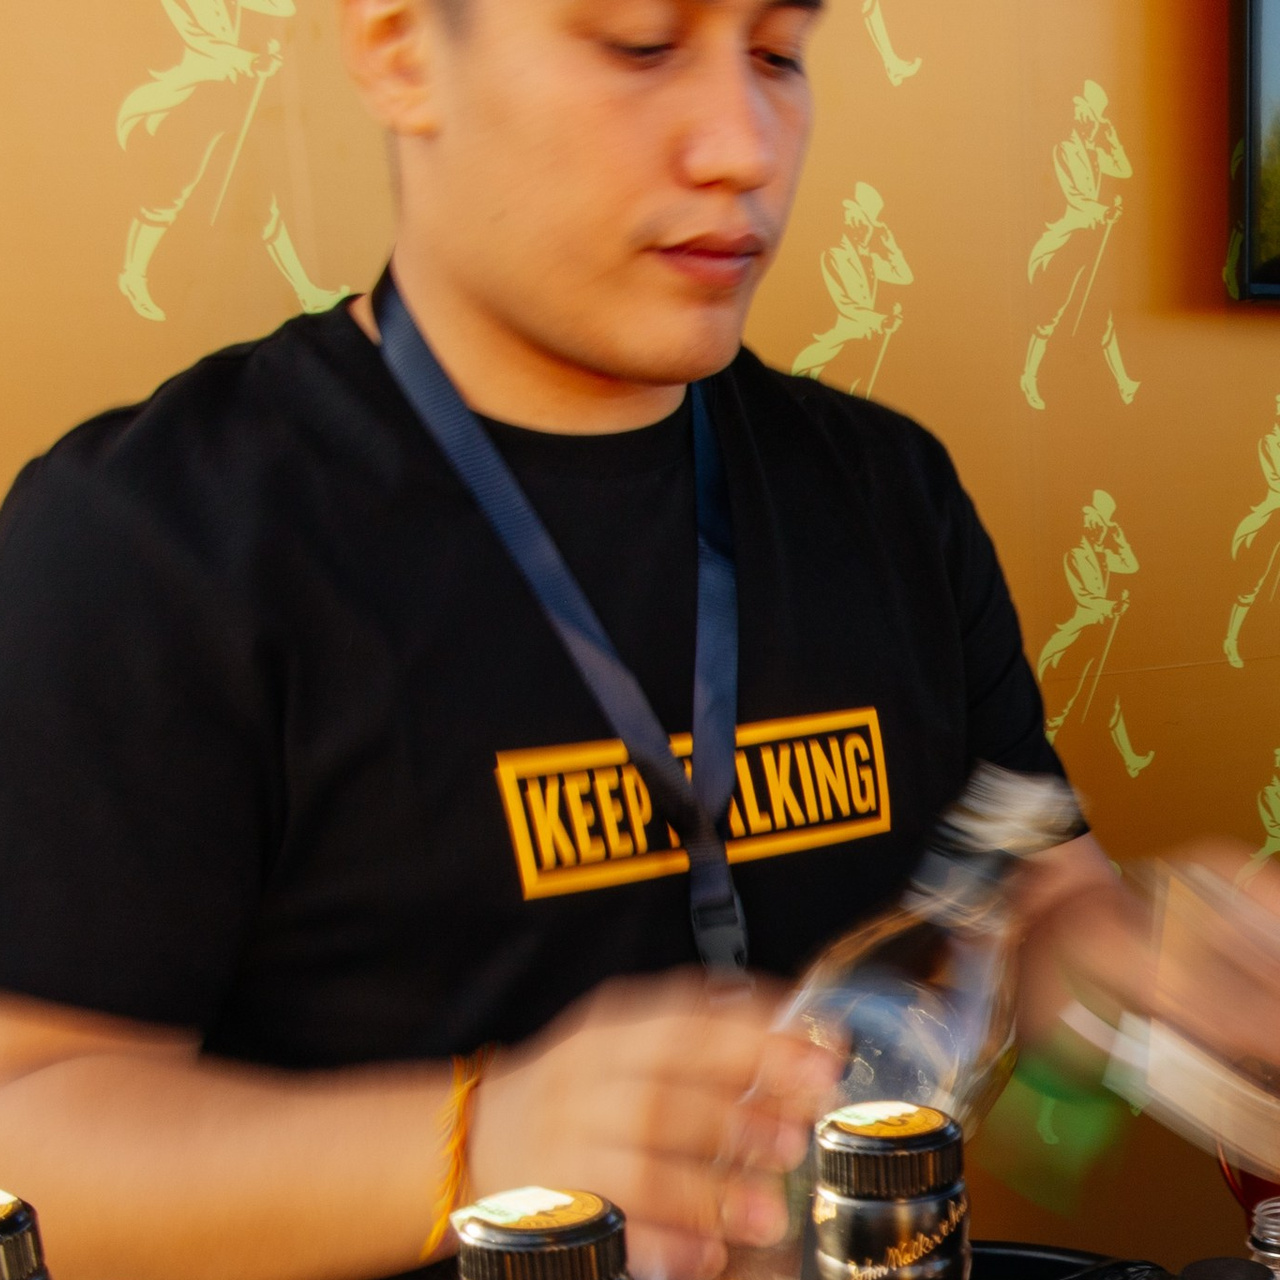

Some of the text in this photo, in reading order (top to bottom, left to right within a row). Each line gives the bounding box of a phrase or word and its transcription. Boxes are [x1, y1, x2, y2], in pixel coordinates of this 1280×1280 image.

[524, 733, 876, 870] KEEP LKING
[886, 1232, 943, 1271] Walker
